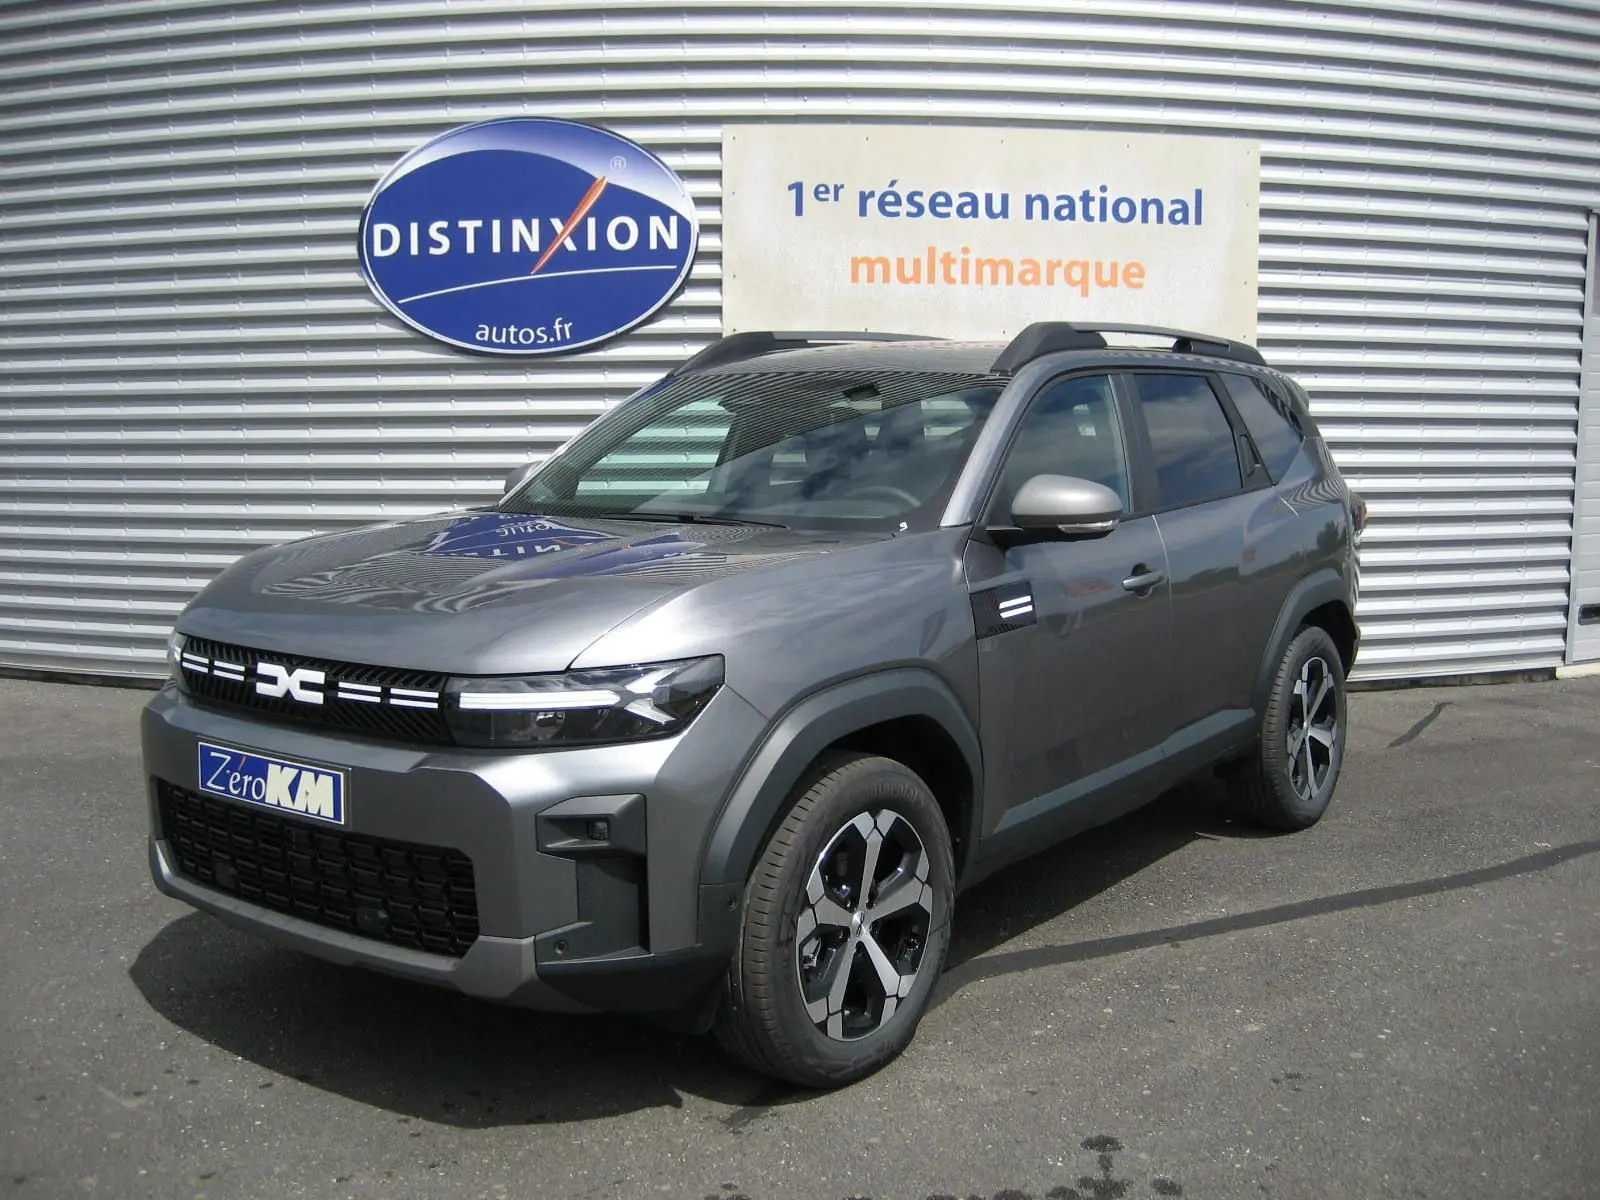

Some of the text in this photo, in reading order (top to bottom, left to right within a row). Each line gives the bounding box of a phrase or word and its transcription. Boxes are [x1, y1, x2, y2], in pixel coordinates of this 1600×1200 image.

[857, 179, 1009, 220] réseau
[1024, 185, 1203, 226] national
[372, 214, 679, 257] DISTINXION
[850, 246, 1146, 298] multimarque
[475, 317, 573, 345] autos.fr
